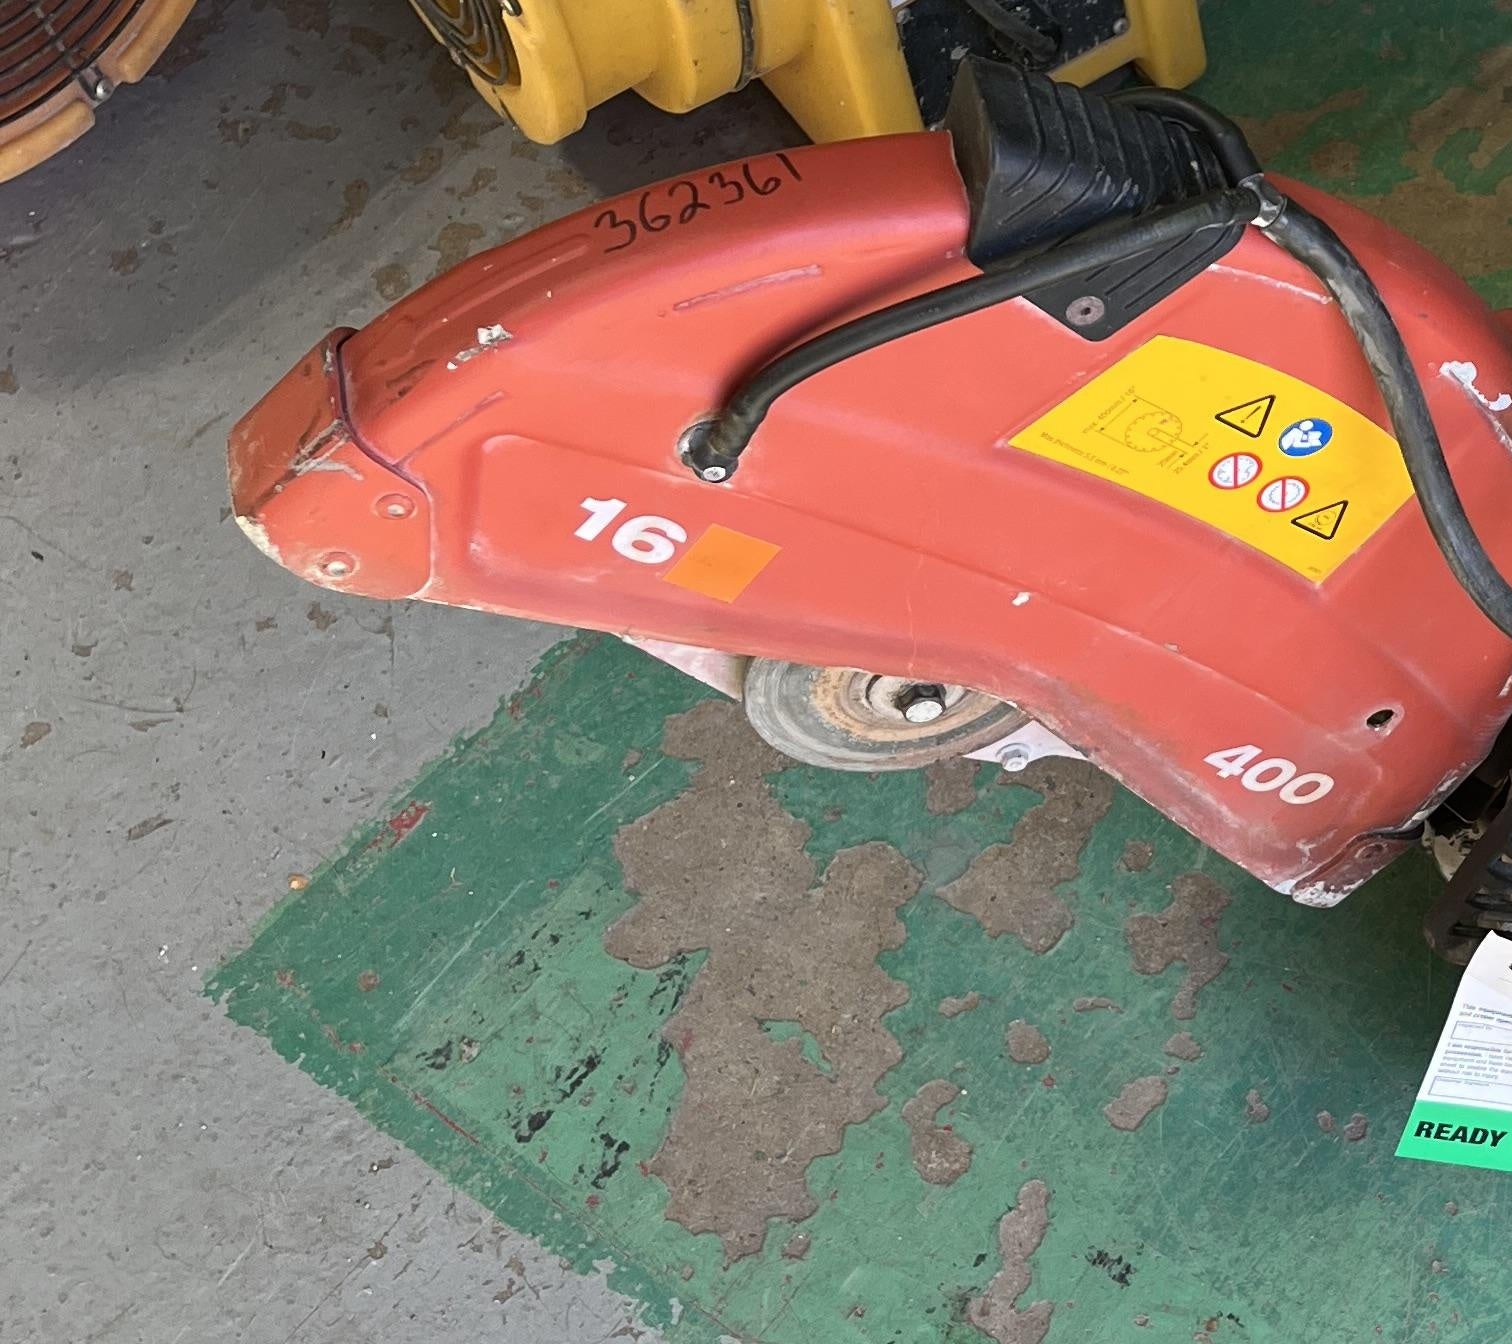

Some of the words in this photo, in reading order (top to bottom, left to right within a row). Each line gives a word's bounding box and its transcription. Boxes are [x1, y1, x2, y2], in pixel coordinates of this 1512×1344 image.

[594, 153, 803, 253] 362361
[573, 496, 689, 565] 16
[1202, 743, 1335, 805] 400
[1414, 1120, 1508, 1148] READY
